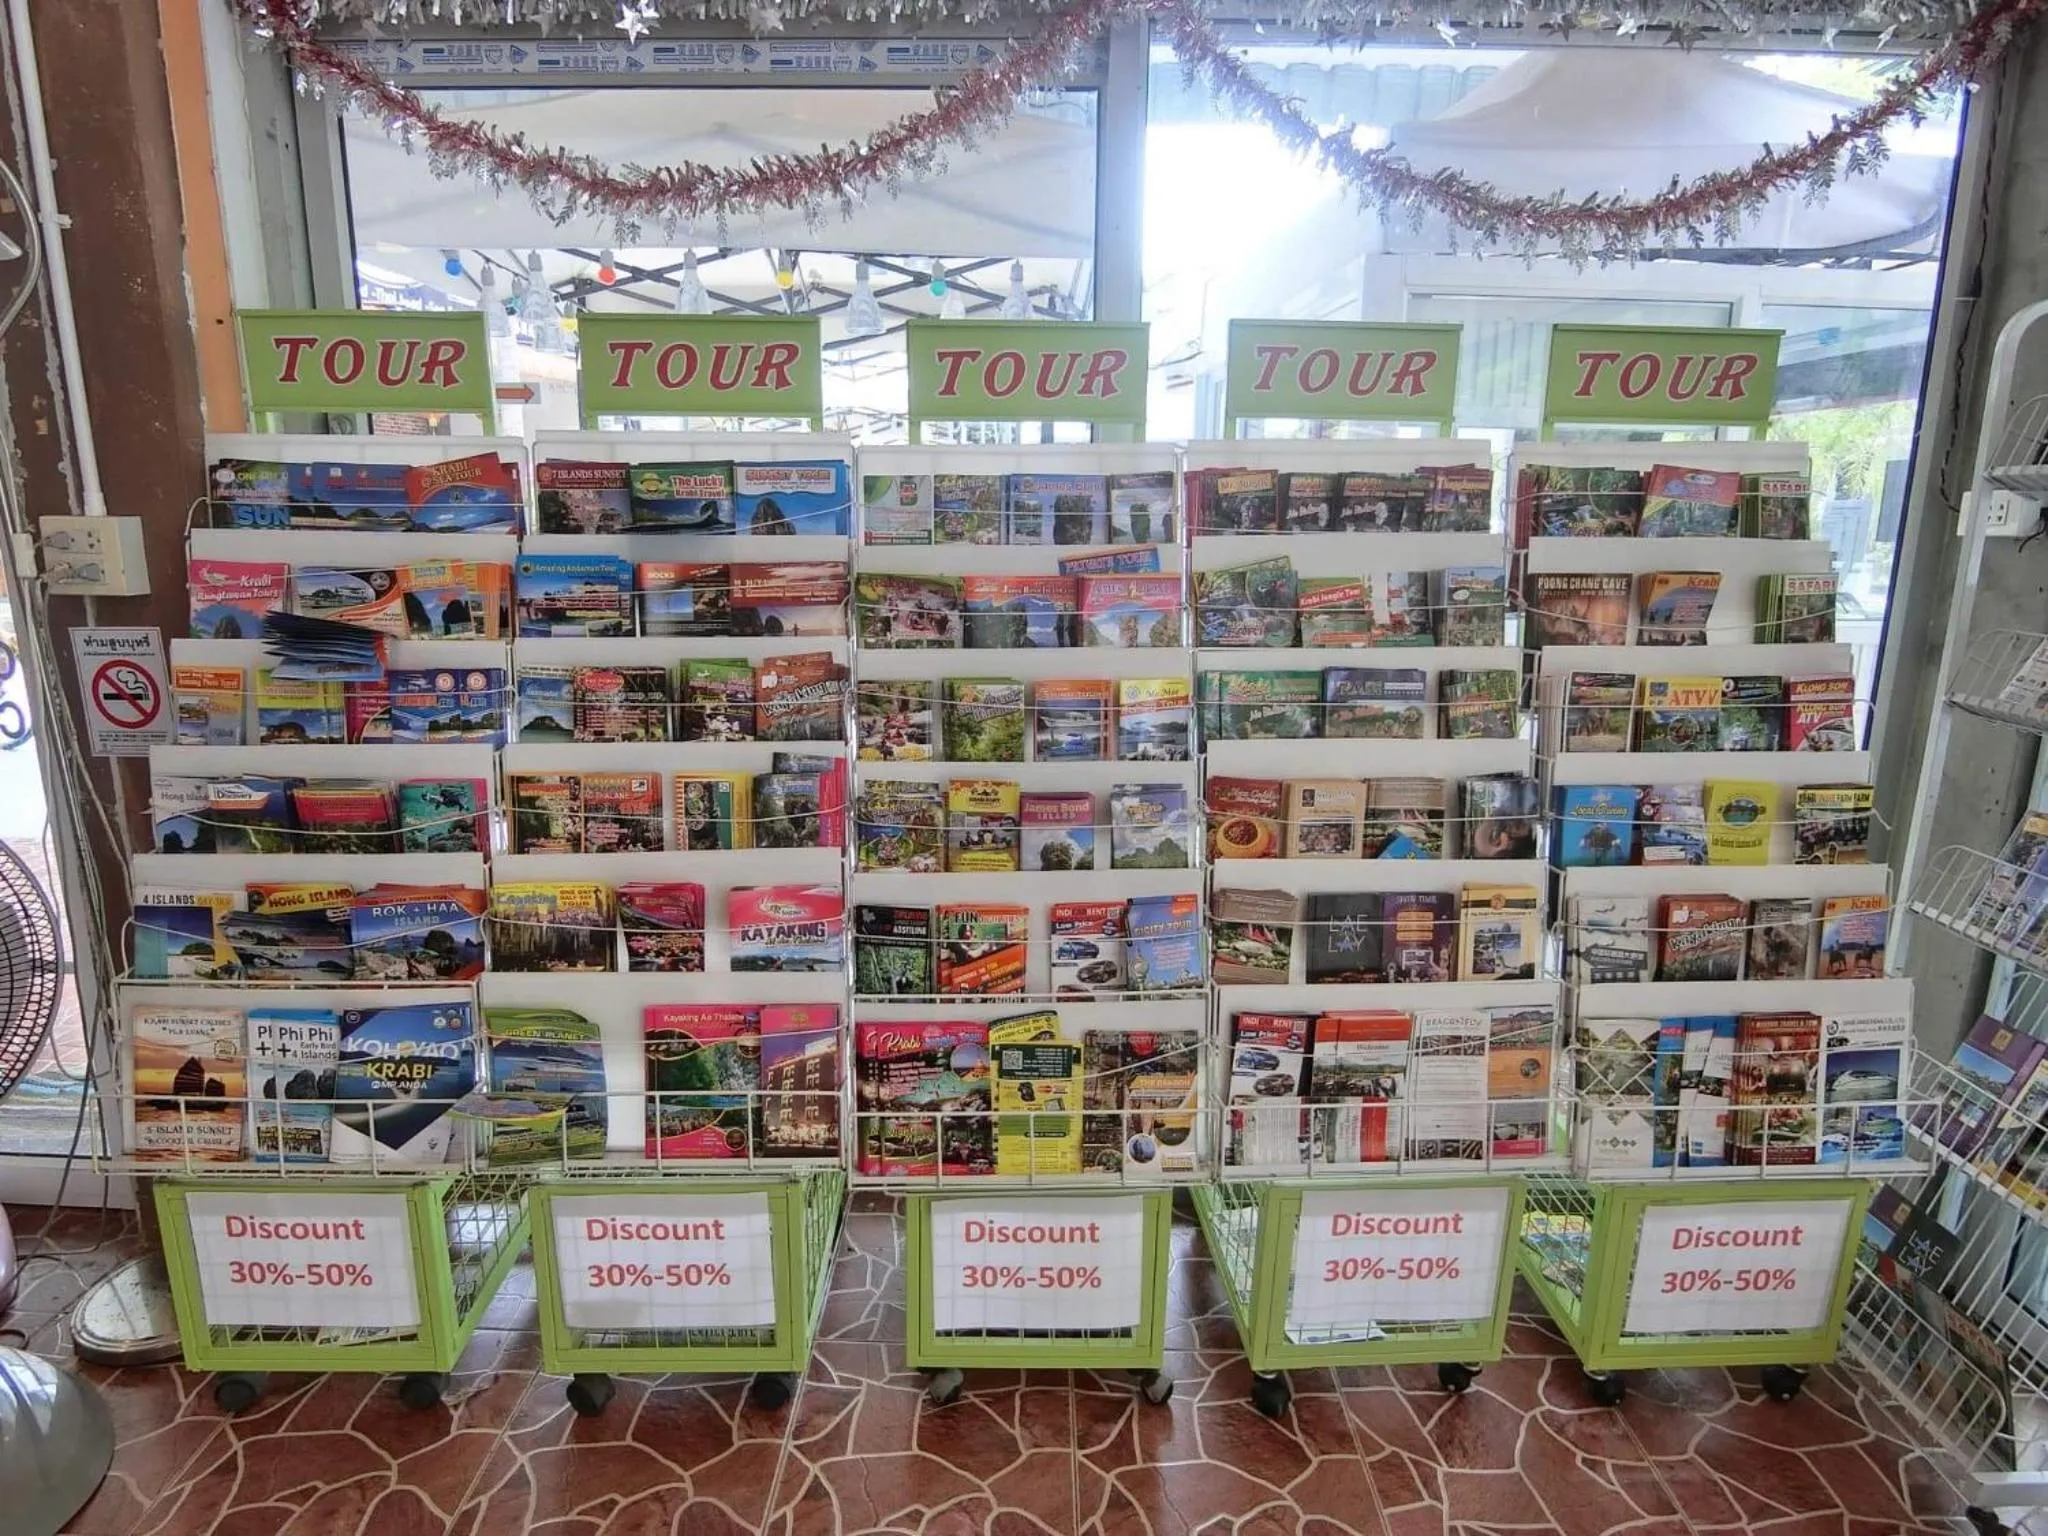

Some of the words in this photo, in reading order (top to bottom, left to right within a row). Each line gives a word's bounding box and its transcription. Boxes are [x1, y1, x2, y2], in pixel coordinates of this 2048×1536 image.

[272, 336, 468, 389] TOUR
[607, 341, 800, 391] TOUR
[1254, 345, 1438, 397] TOUR
[935, 348, 1128, 398] TOUR
[1574, 351, 1759, 400] TOUR
[558, 470, 593, 478] ISLANDS
[673, 476, 692, 487] The
[693, 475, 723, 488] Lucky
[700, 488, 725, 498] Travel
[237, 504, 289, 525] SUN
[84, 634, 150, 651] ห้ามสูบบุหรี่
[1060, 801, 1089, 812] Bond
[143, 896, 149, 904] 4
[152, 895, 195, 905] ISLANDS
[269, 894, 306, 908] HONG
[309, 888, 351, 903] ISLAND
[373, 905, 407, 917] ROK
[427, 903, 460, 913] HAA
[955, 911, 978, 923] FUN
[394, 916, 441, 926] ISLAND
[1330, 914, 1368, 932] LAE
[741, 922, 825, 941] KAYAKING
[280, 1027, 304, 1041] Phi
[309, 1028, 333, 1041] Phi
[301, 1050, 337, 1059] Islands
[366, 1062, 433, 1079] KRABI
[196, 1126, 234, 1135] SUNSET
[225, 1215, 366, 1240] Discount
[586, 1216, 726, 1242] Discount
[964, 1219, 1100, 1244] Discount
[1330, 1211, 1464, 1237] Discount
[1672, 1225, 1804, 1250] Discount
[229, 1261, 373, 1287] 30%-50%
[588, 1263, 731, 1288] 30%-50%
[961, 1264, 1102, 1289] 30%-50%
[1322, 1256, 1460, 1282] 30%-50%
[1660, 1268, 1797, 1294] 30%-50%
